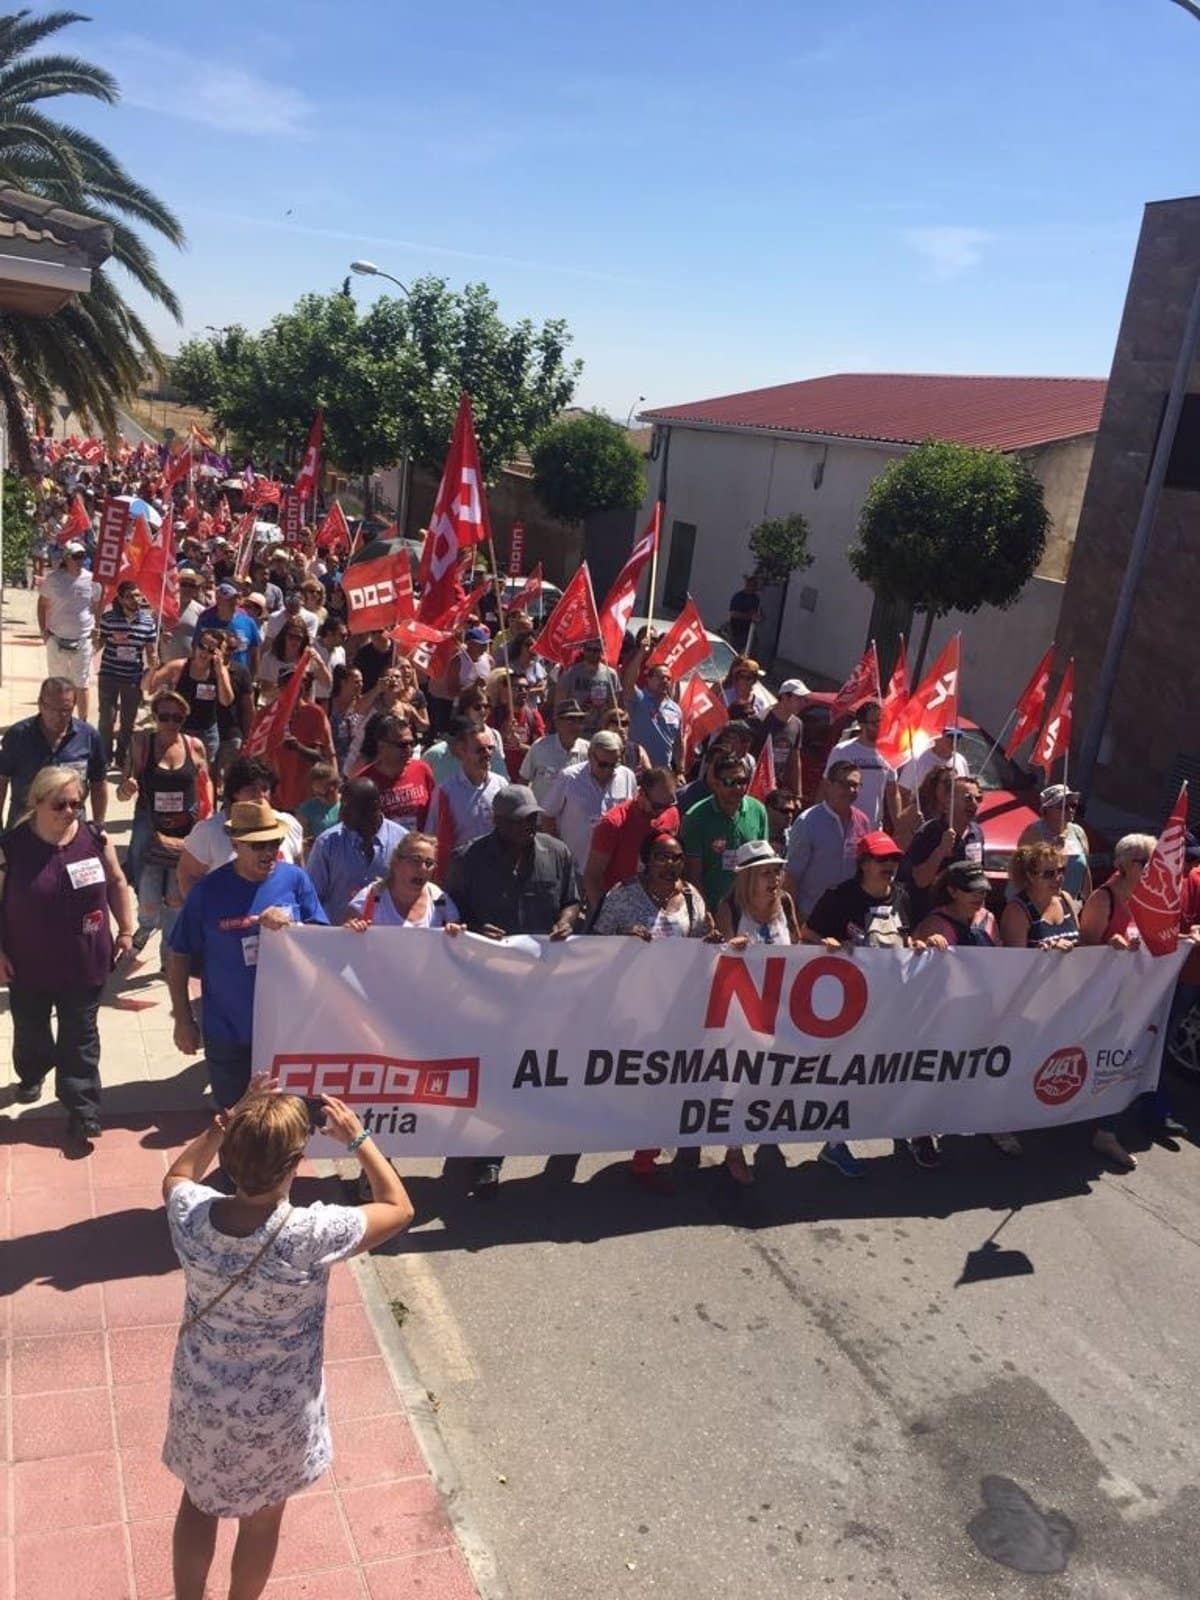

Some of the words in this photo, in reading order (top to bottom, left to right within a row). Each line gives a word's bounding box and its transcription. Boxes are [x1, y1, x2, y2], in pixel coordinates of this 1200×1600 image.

[704, 955, 869, 1039] NO
[277, 1063, 421, 1096] CCOO
[512, 1049, 569, 1088] AL
[584, 1045, 1012, 1087] DESMANTELAMIENTO
[1044, 1053, 1083, 1078] UGT
[679, 1100, 732, 1135] DE
[744, 1098, 851, 1133] SADA
